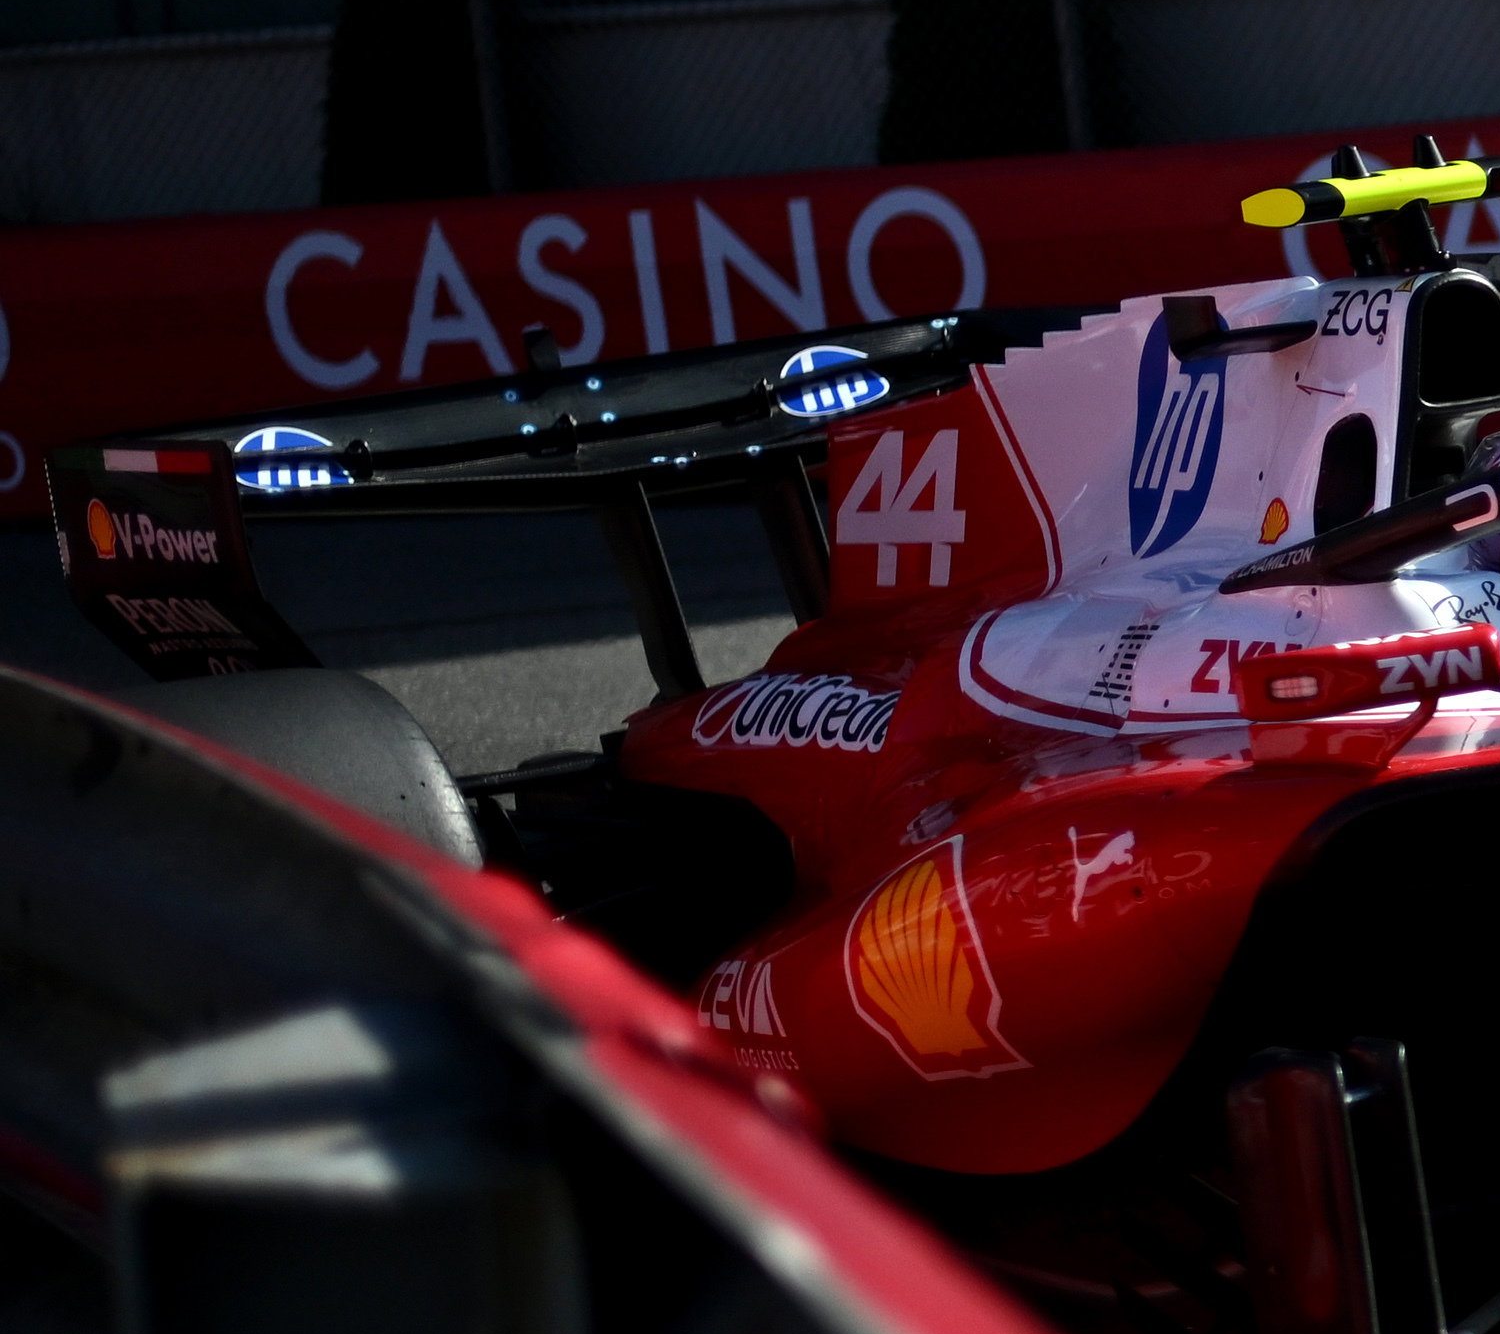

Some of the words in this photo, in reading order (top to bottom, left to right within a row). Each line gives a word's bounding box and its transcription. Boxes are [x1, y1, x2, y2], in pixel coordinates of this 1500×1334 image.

[265, 184, 988, 391] CASINO
[836, 428, 966, 587] 44
[1134, 341, 1220, 560] hp
[112, 512, 220, 565] V-Power
[1376, 645, 1484, 695] ZYN
